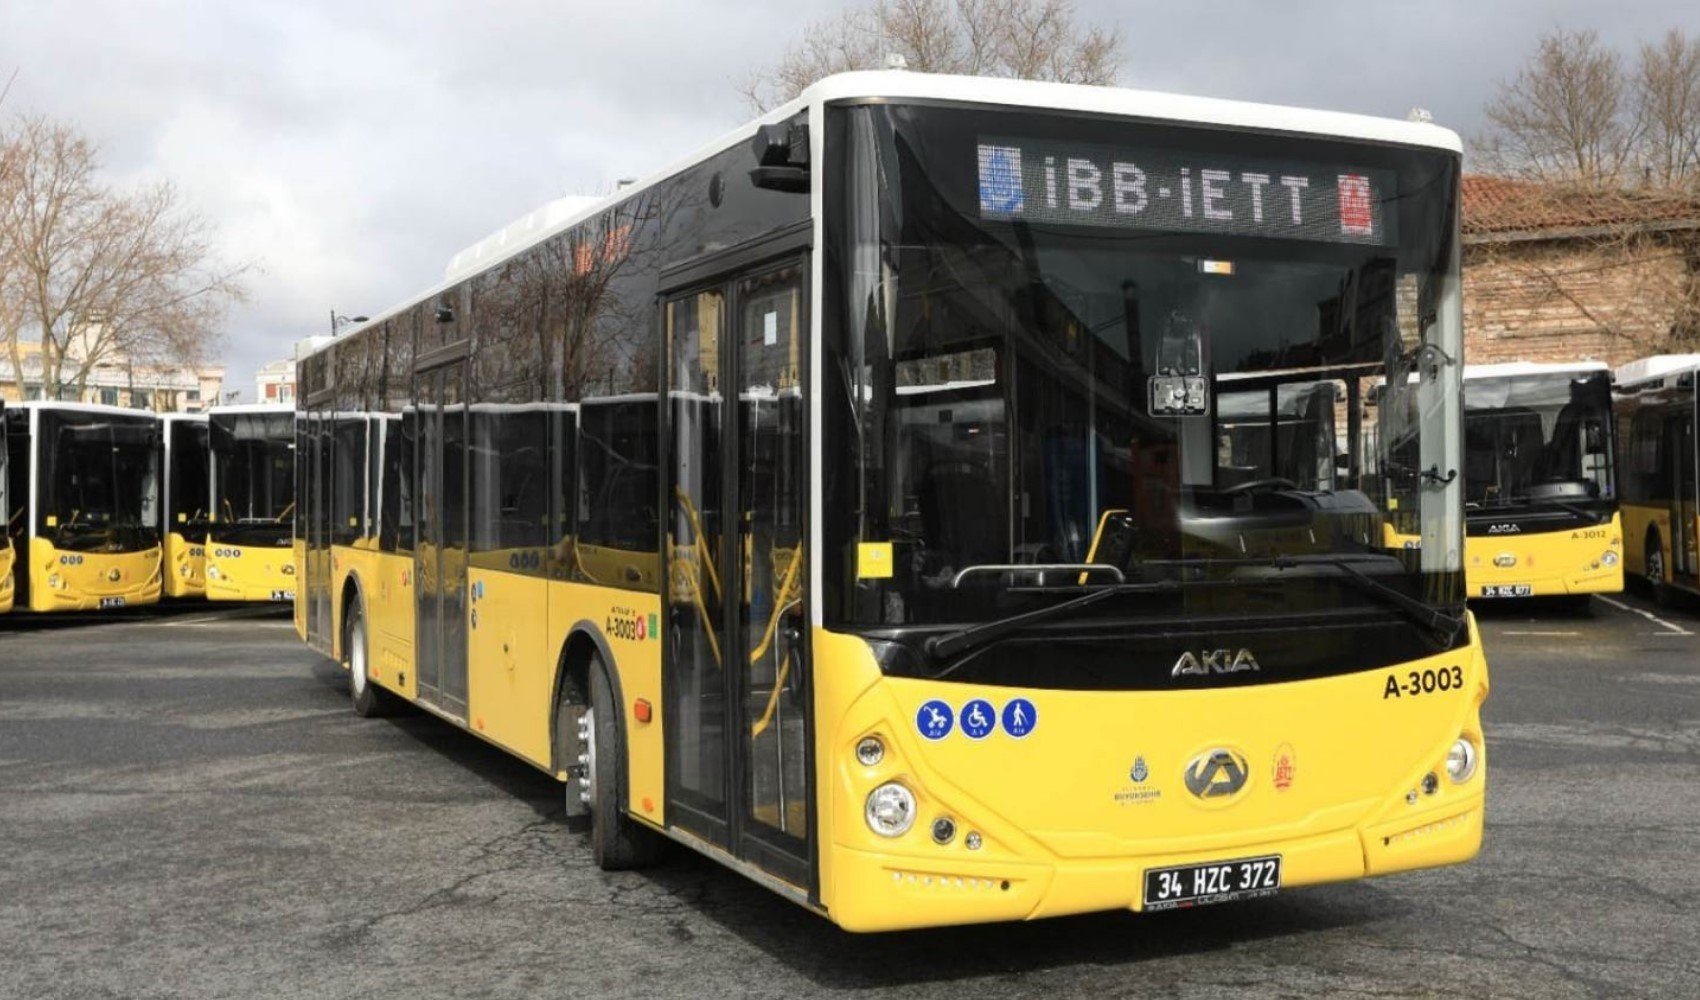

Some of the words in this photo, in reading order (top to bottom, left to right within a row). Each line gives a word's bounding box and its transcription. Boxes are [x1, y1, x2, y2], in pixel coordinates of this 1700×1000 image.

[606, 616, 636, 641] A-3003
[1171, 648, 1260, 677] AKIA
[1383, 665, 1463, 700] A-3003
[1157, 872, 1183, 899] 34
[1193, 865, 1232, 895] HZC
[1239, 860, 1276, 889] 372
